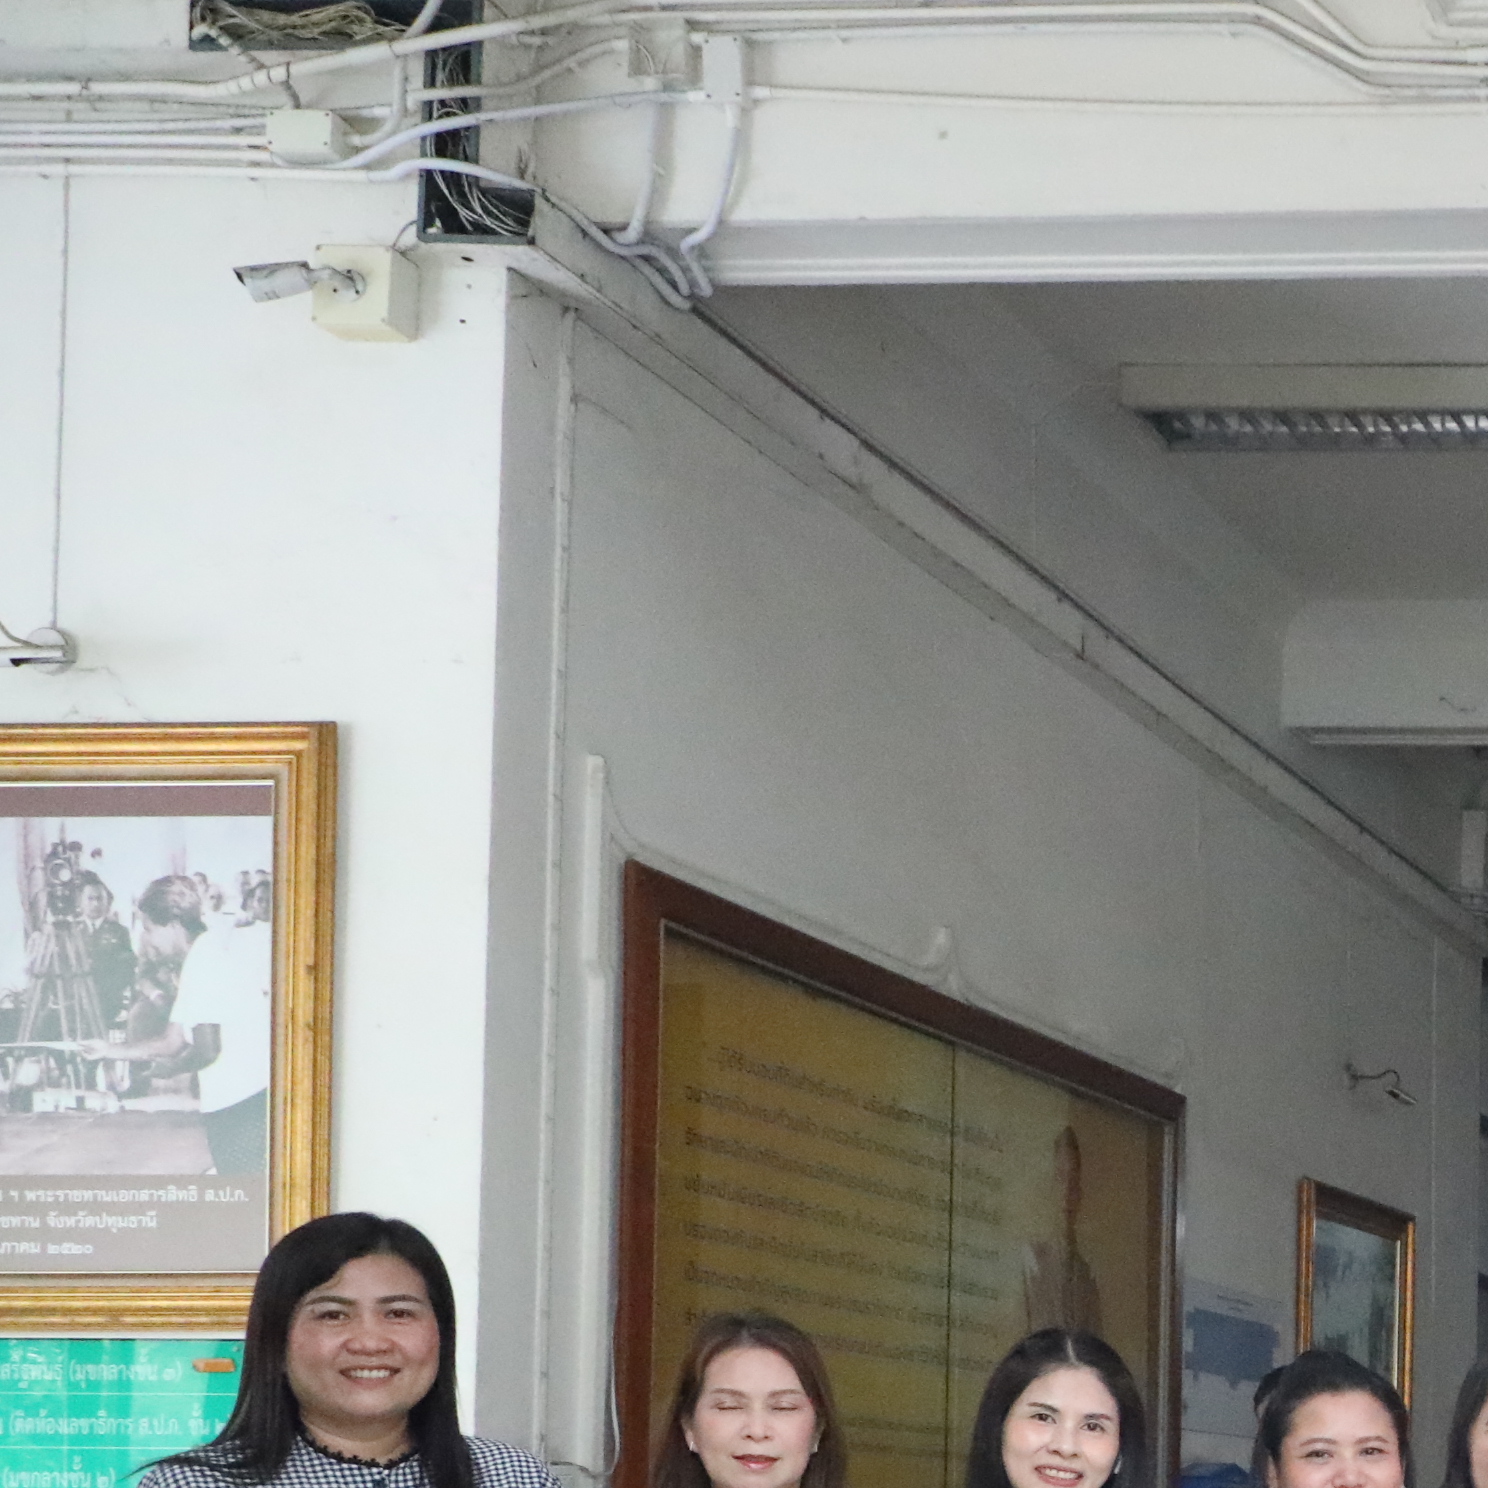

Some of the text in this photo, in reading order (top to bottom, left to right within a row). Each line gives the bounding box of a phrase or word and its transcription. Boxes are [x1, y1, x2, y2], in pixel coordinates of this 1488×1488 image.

[204, 1187, 250, 1203] ส.ป.ก.
[46, 1210, 157, 1233] จังหวัดปทุมธานี
